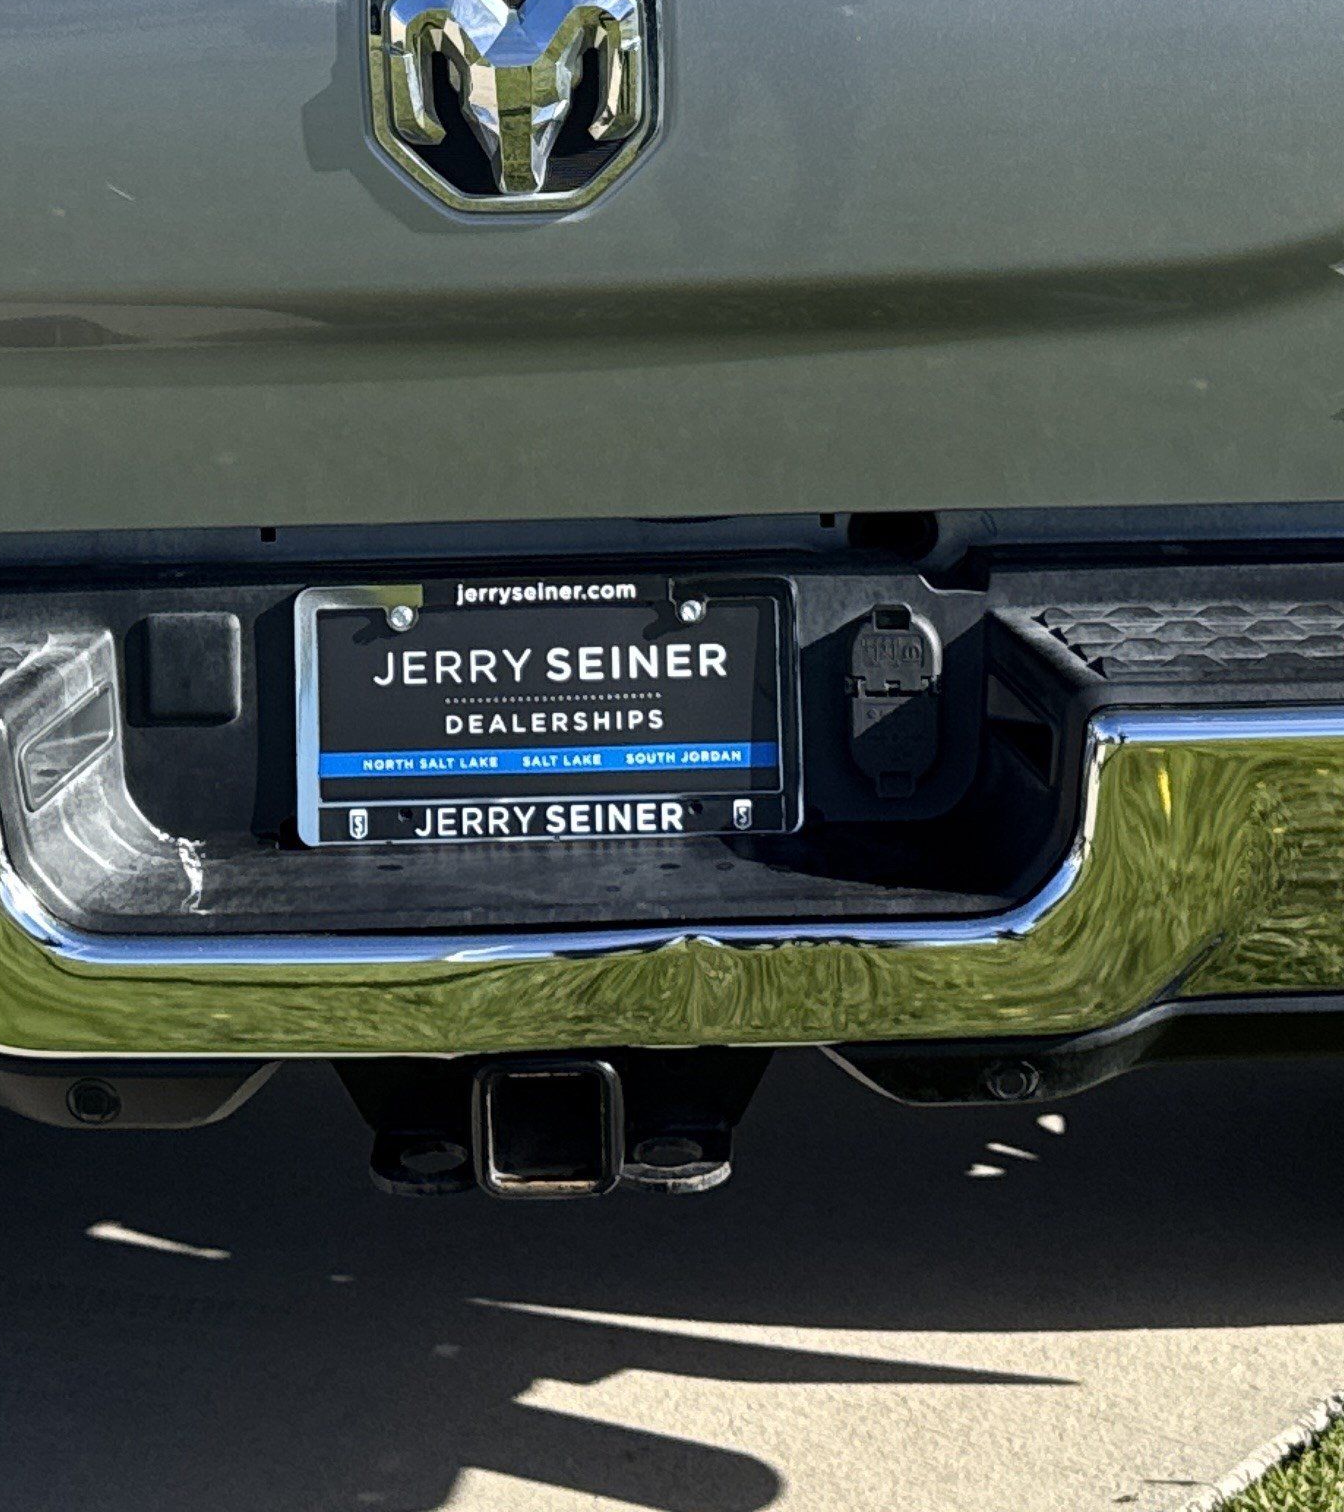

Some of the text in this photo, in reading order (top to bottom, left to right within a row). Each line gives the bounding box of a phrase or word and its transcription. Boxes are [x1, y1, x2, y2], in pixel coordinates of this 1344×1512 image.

[456, 581, 637, 606] jerryseiner.com
[372, 643, 728, 686] JERRY SEINER
[445, 709, 665, 736] DEALERSHIPS
[363, 755, 499, 771] NORTH SALT LAKE
[522, 753, 602, 768] SALT LAKE
[625, 749, 742, 765] SOUTH JORDAN
[415, 802, 684, 837] JERRY SEINER
